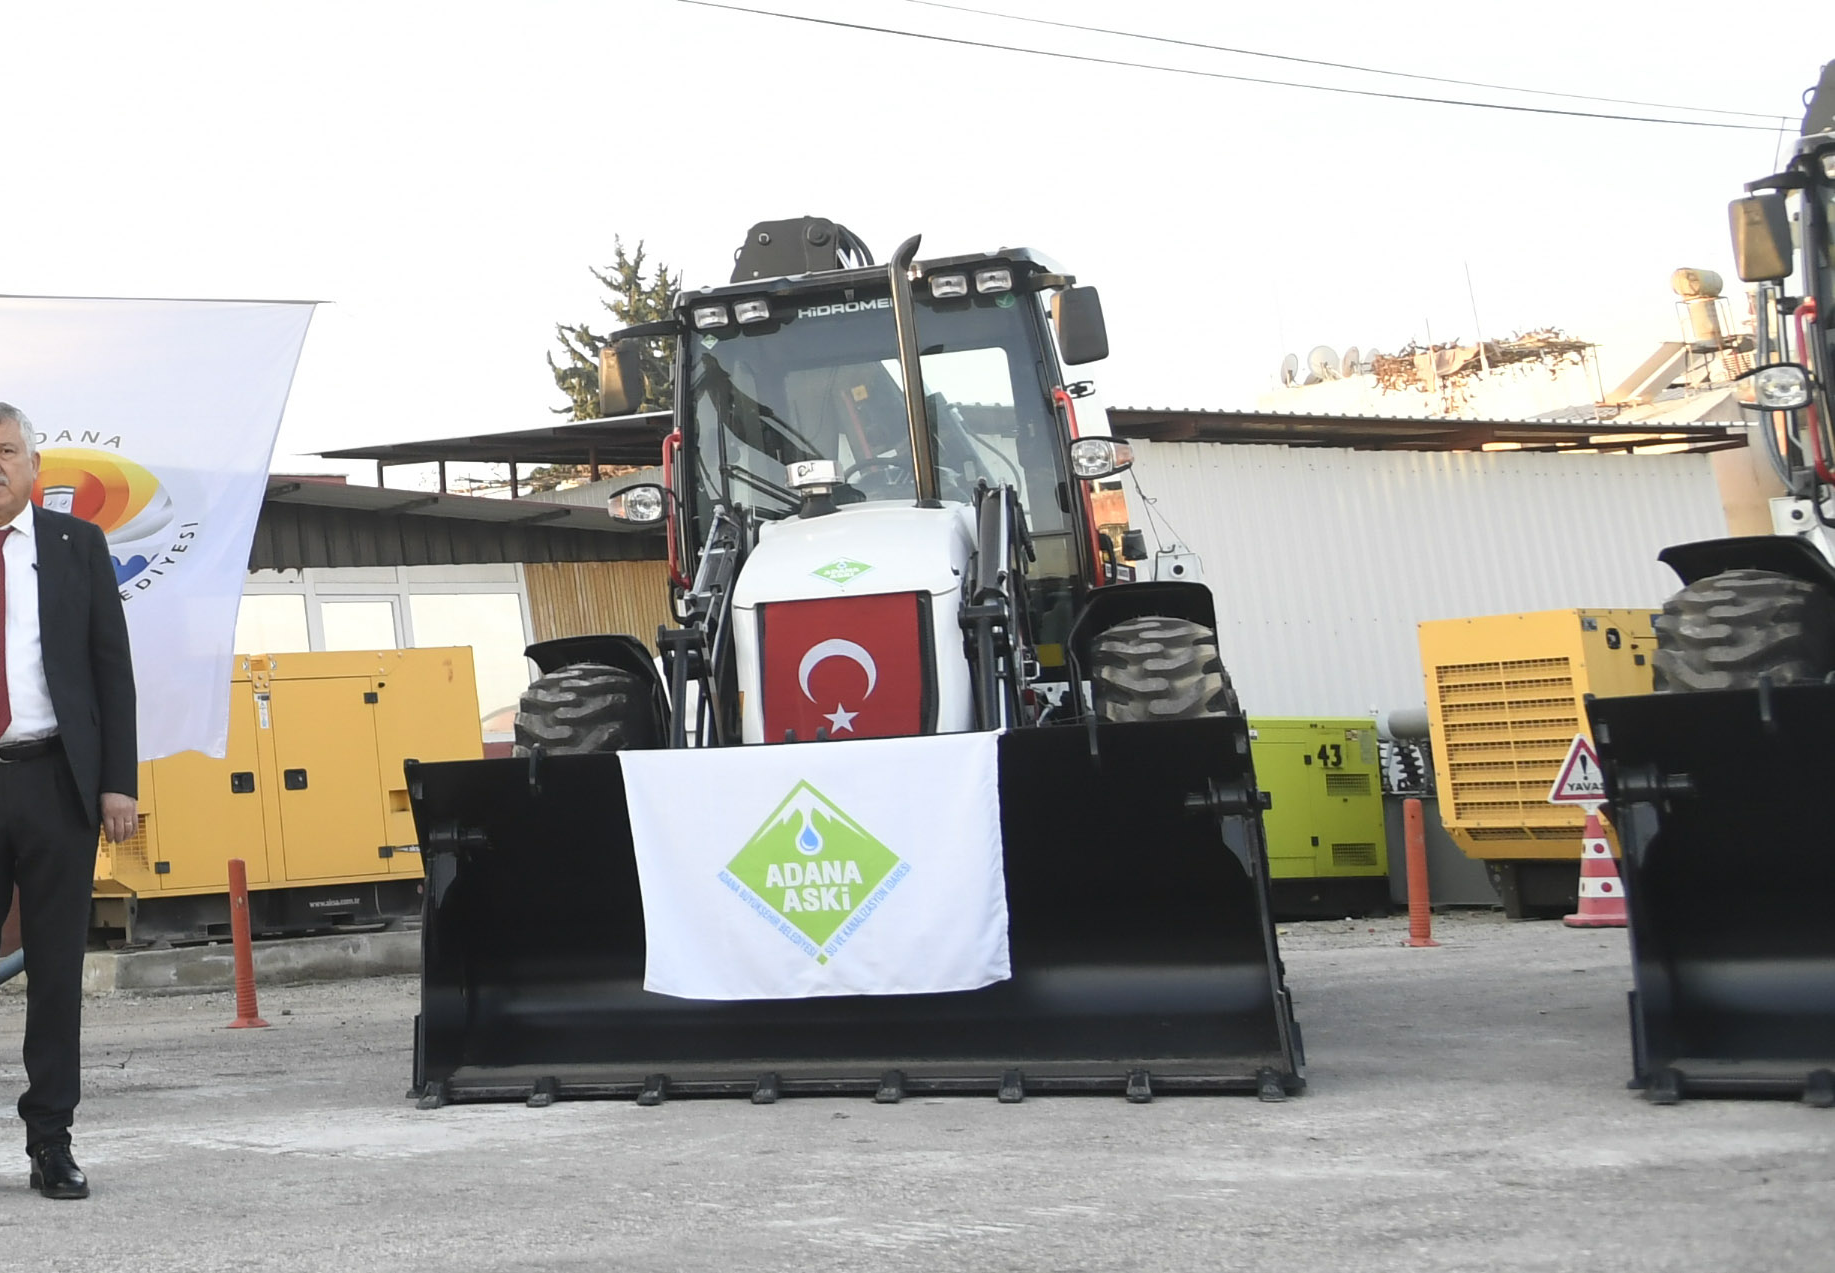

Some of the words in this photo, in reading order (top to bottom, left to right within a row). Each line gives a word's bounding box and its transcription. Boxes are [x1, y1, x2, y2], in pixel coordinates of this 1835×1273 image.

[35, 430, 121, 448] DANA
[1317, 744, 1342, 767] 43
[766, 859, 863, 888] ADANA
[825, 942, 839, 957] SU
[833, 933, 847, 946] VE
